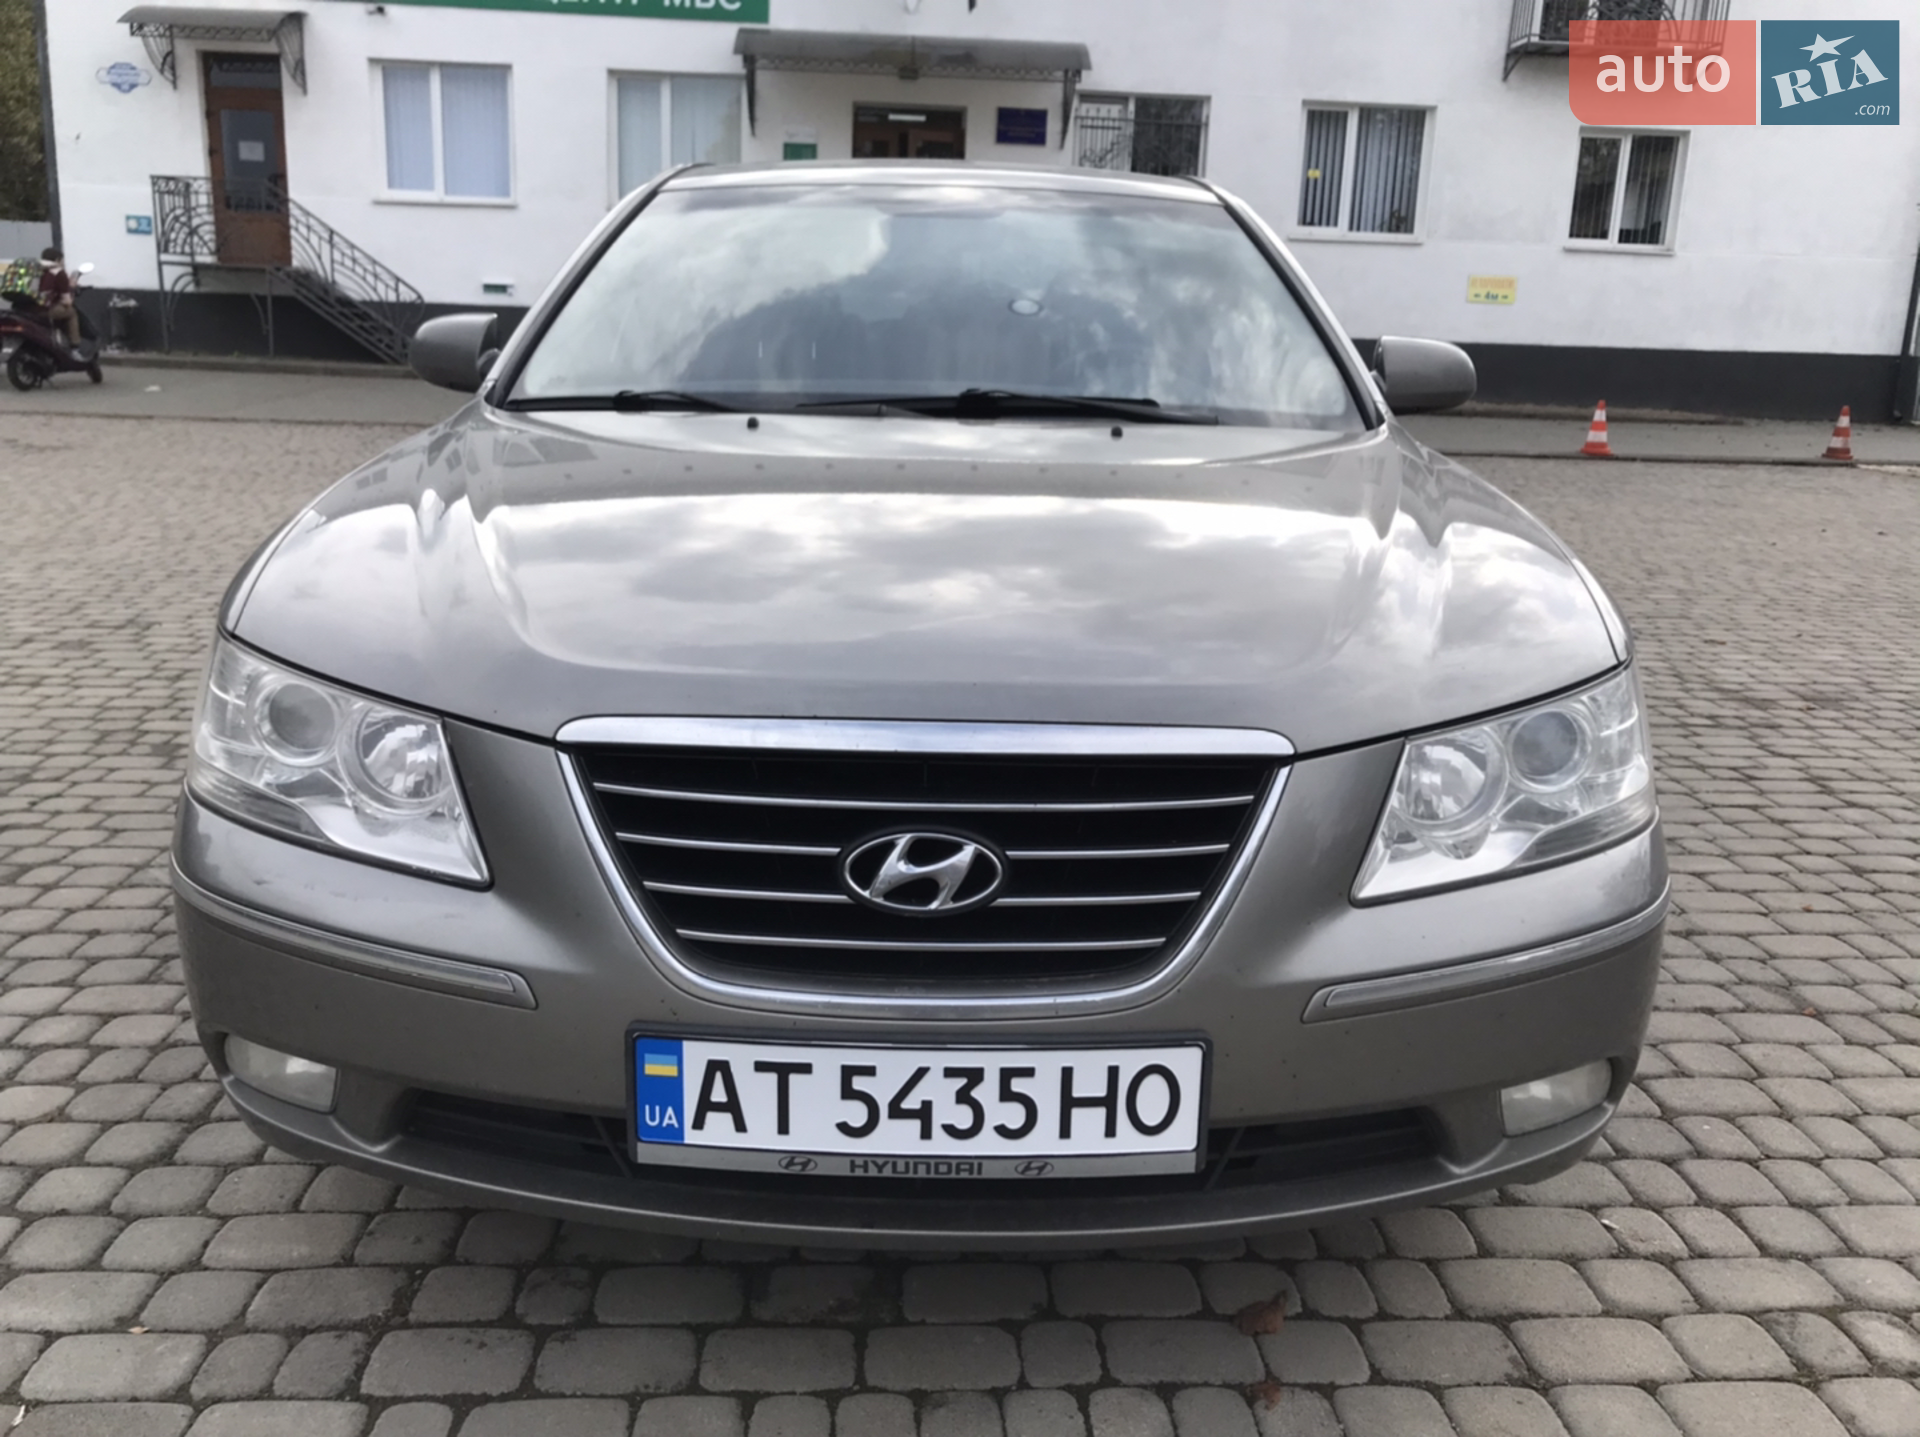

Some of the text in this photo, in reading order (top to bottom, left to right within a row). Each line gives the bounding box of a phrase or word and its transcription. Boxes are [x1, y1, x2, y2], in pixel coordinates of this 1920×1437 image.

[691, 1059, 813, 1136] AT
[835, 1064, 1039, 1141] 5435
[644, 1104, 679, 1128] UA
[849, 1159, 984, 1176] HYUNDAI
